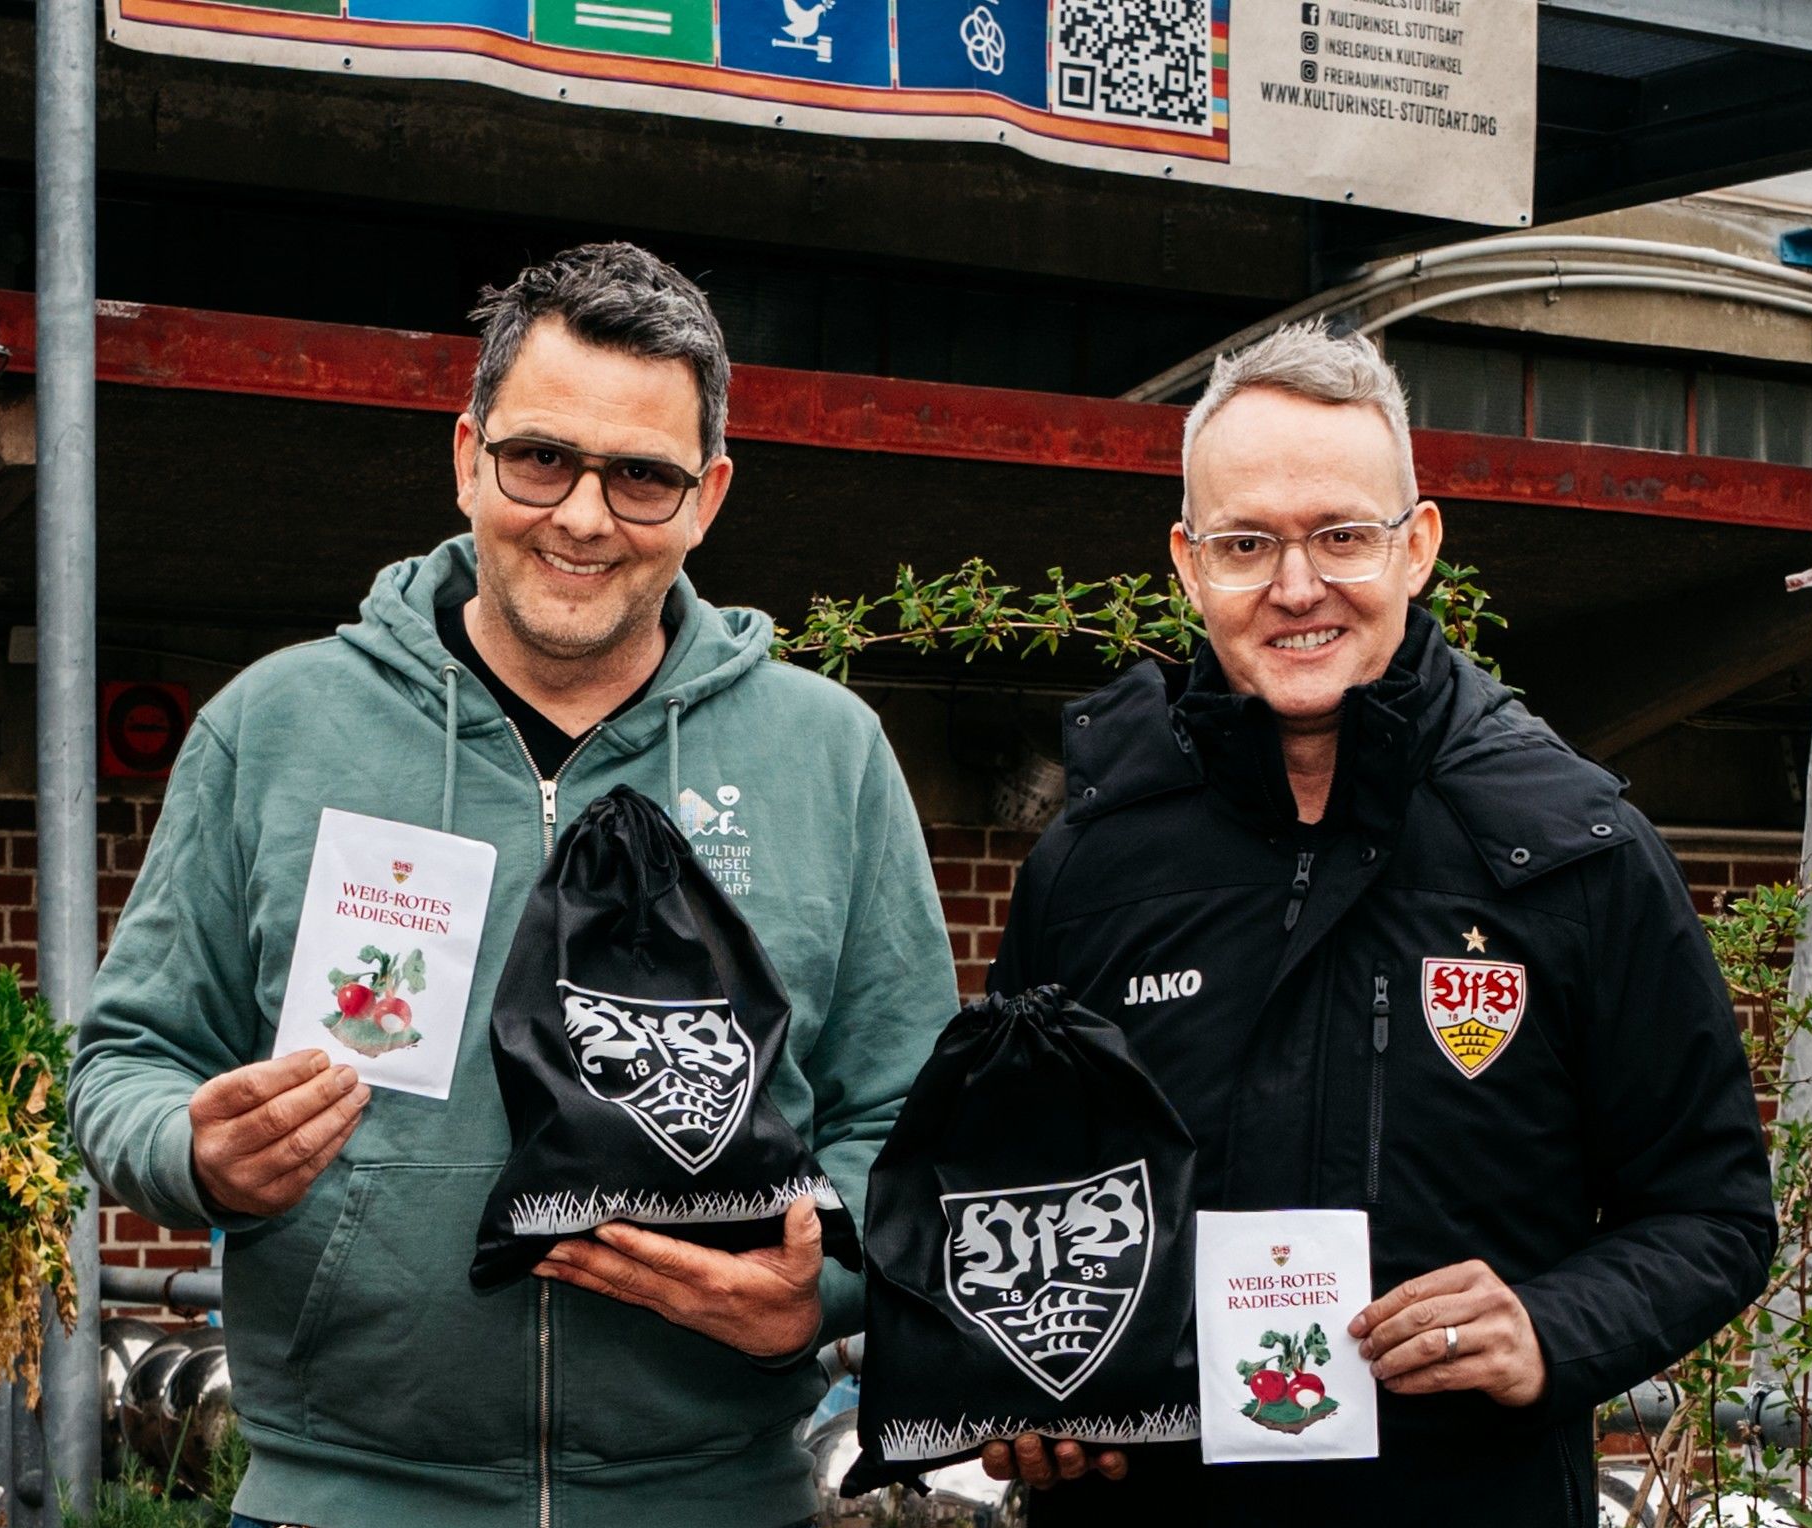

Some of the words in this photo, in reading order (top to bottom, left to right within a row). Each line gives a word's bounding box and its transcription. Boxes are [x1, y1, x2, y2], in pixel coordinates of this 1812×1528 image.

[1325, 38, 1463, 75] INSELGRUEN.KULTURINSEL
[1324, 67, 1450, 100] FREIRAUMINSTUTTGART
[1260, 81, 1497, 136] WWW.KULTURINSEL-STUTTGART.ORG
[695, 844, 751, 857] KULTUR
[708, 858, 750, 870] INSEL
[723, 883, 751, 896] ART
[336, 901, 450, 935] RADIESCHEN
[1124, 969, 1202, 1005] JAKO
[1448, 1013, 1458, 1022] 18
[1487, 1015, 1499, 1024] 93
[625, 1059, 650, 1081] 18
[997, 1290, 1023, 1303] 18
[1080, 1263, 1107, 1281] 93
[1228, 1291, 1339, 1310] RADIESCHEN
